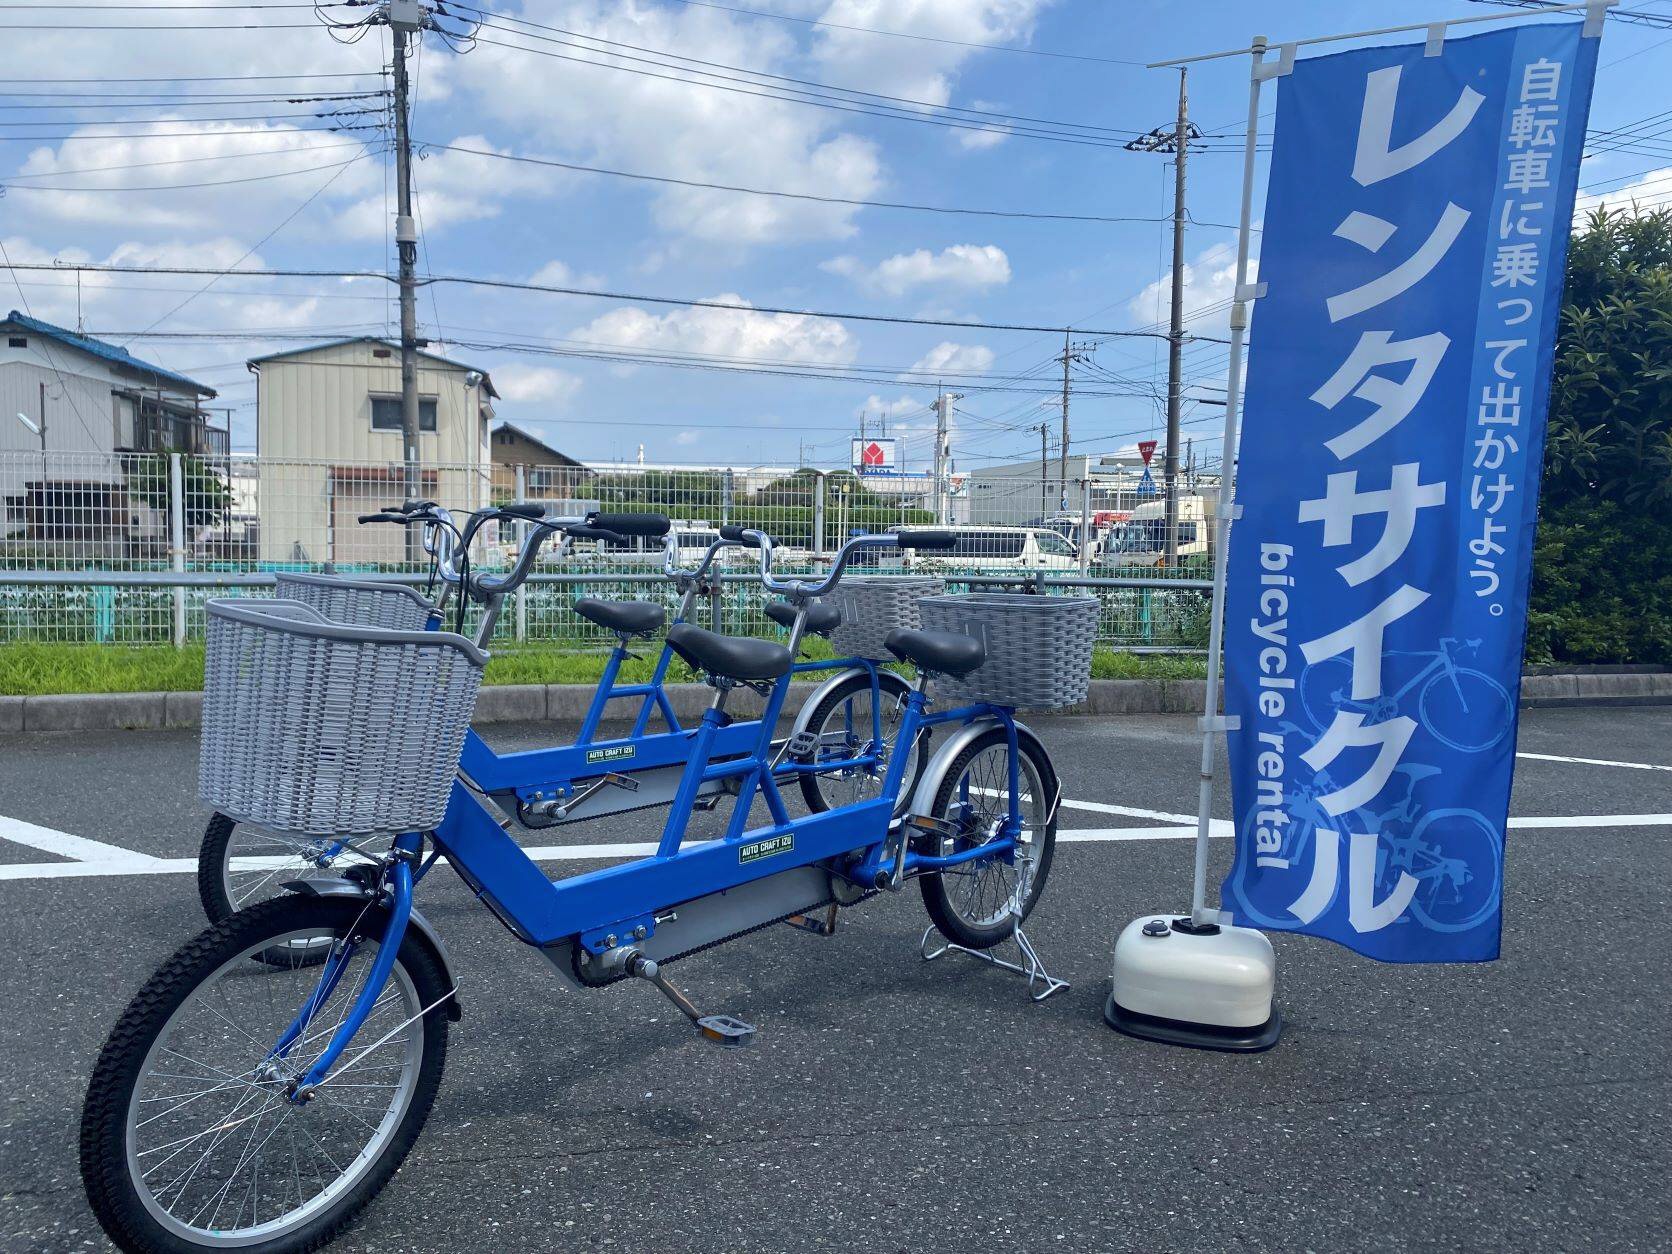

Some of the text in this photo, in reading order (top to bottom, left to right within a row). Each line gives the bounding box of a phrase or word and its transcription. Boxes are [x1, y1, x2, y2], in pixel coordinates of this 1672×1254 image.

[1287, 64, 1486, 934] レンタサイクル
[1470, 58, 1562, 617] 自転車に乗って出かけよう。
[589, 751, 603, 759] AUTO
[605, 749, 622, 757] CRAFT
[623, 746, 633, 754] IZU
[742, 844, 759, 857] AUTO
[760, 839, 780, 852] CRAFT
[781, 835, 792, 847] IZU
[1251, 543, 1295, 870] bicycle rental
